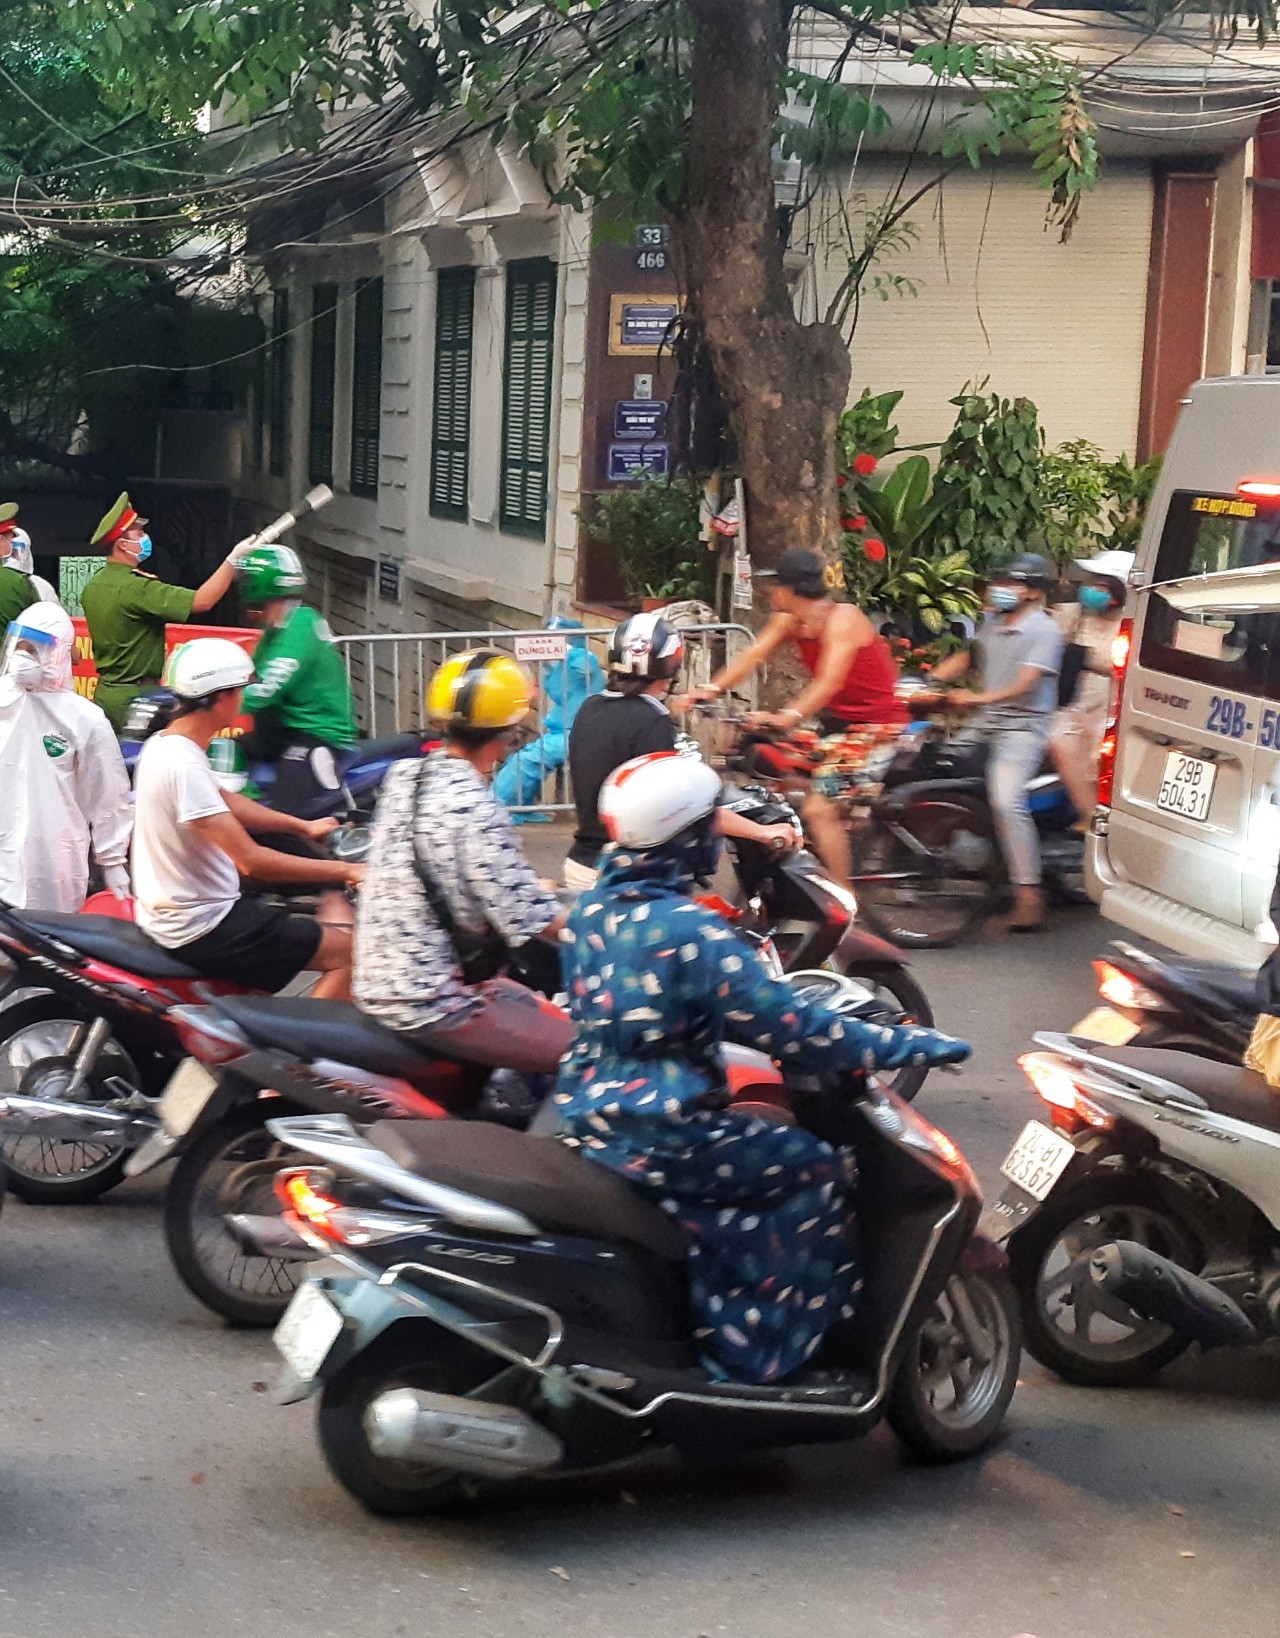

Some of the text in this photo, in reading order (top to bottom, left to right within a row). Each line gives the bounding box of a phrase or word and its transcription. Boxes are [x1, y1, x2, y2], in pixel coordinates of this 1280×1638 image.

[642, 228, 661, 245] 33
[637, 252, 665, 270] 466
[1175, 758, 1203, 785] 29B
[1159, 781, 1207, 818] 504.31
